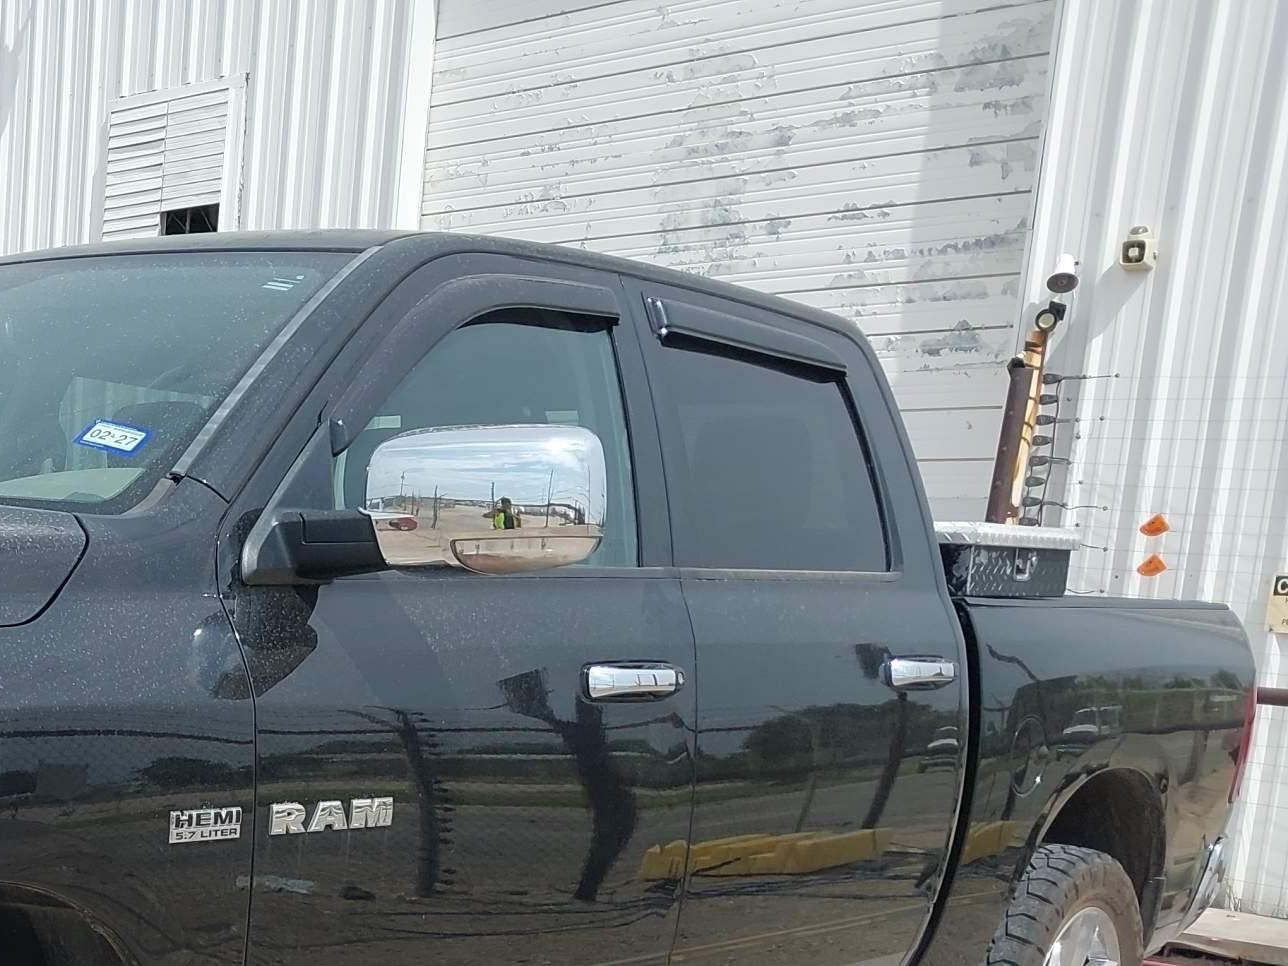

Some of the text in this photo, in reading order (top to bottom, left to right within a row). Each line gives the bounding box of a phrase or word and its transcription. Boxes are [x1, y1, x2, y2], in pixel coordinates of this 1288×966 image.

[173, 806, 242, 829] HEMI
[268, 796, 394, 836] RAM
[175, 827, 238, 841] 5.7 LITER
